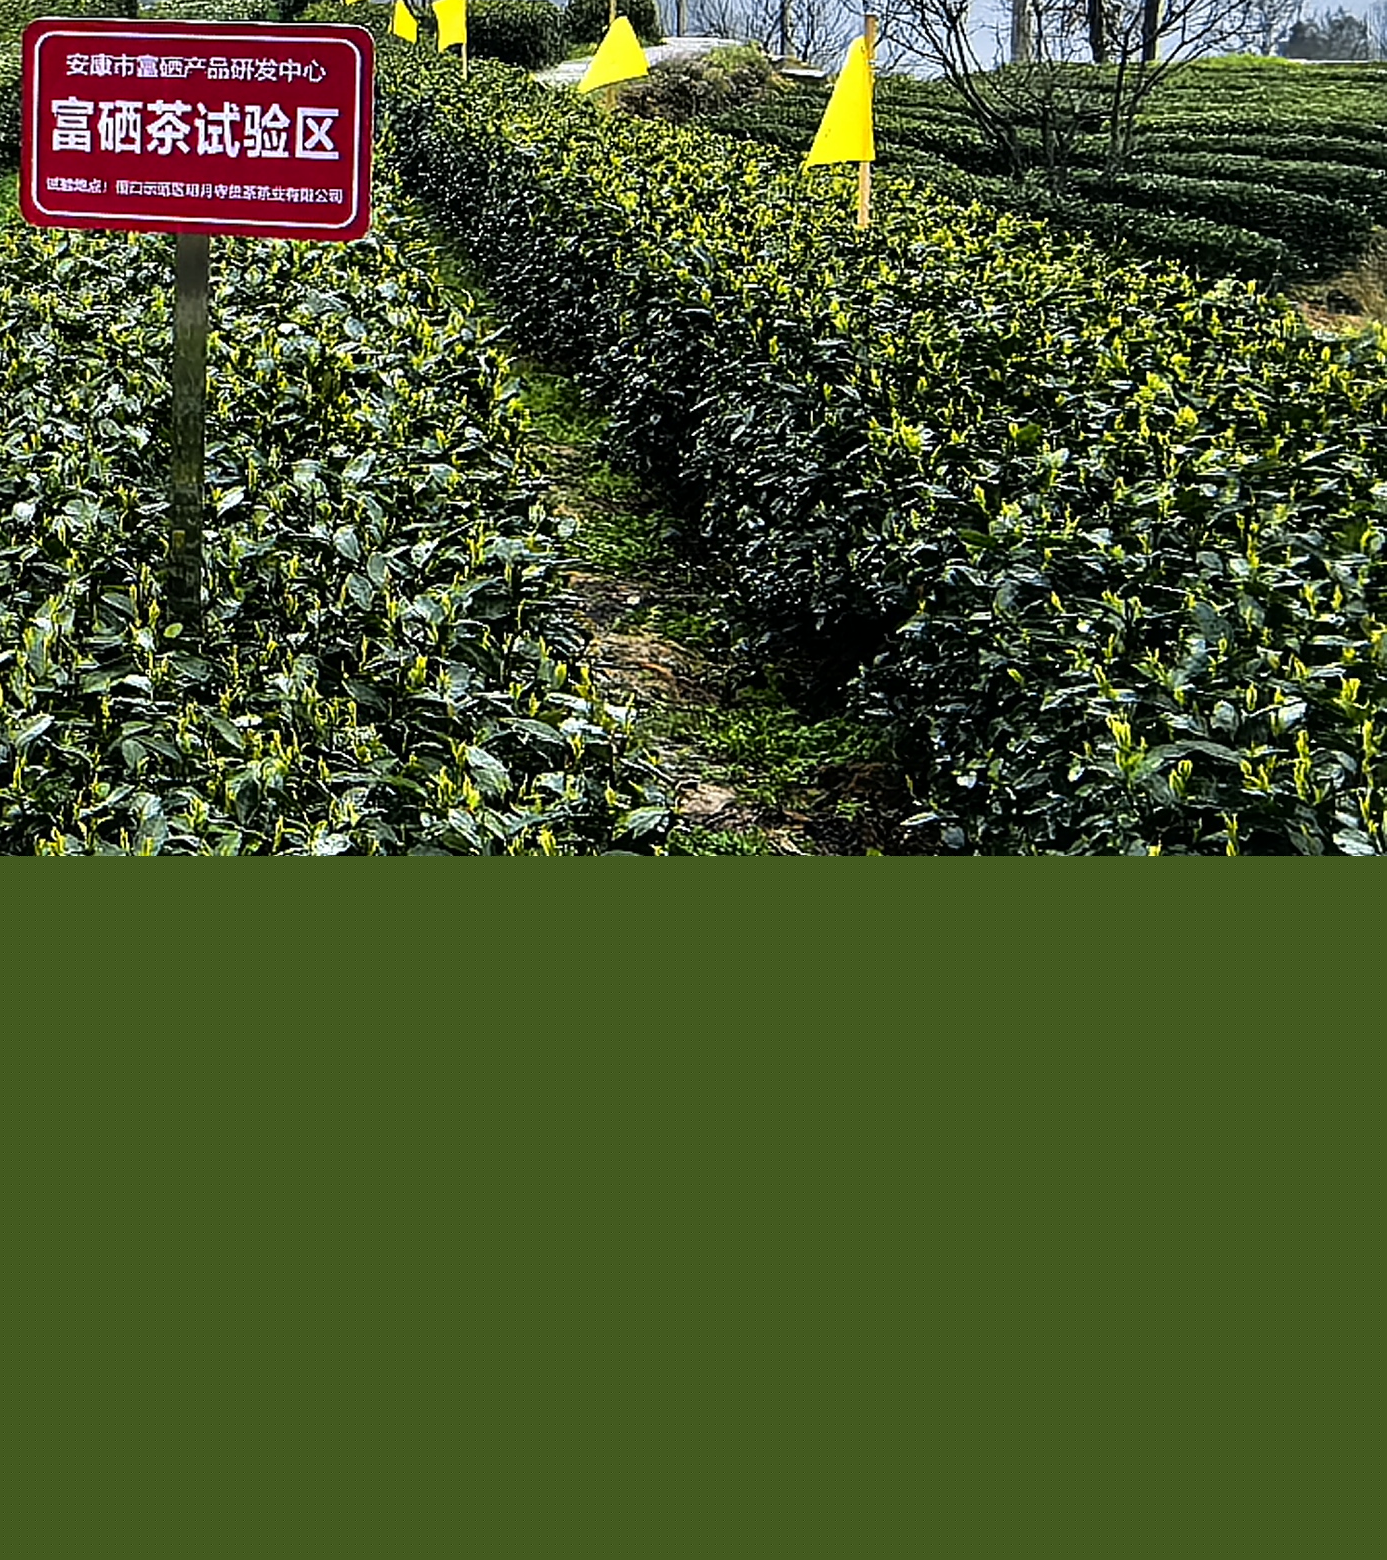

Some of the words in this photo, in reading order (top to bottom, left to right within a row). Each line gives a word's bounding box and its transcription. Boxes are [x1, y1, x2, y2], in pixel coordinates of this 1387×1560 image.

[66, 53, 327, 82] 安康市富硒产品研发中心
[51, 97, 339, 159] 富硒茶试验区
